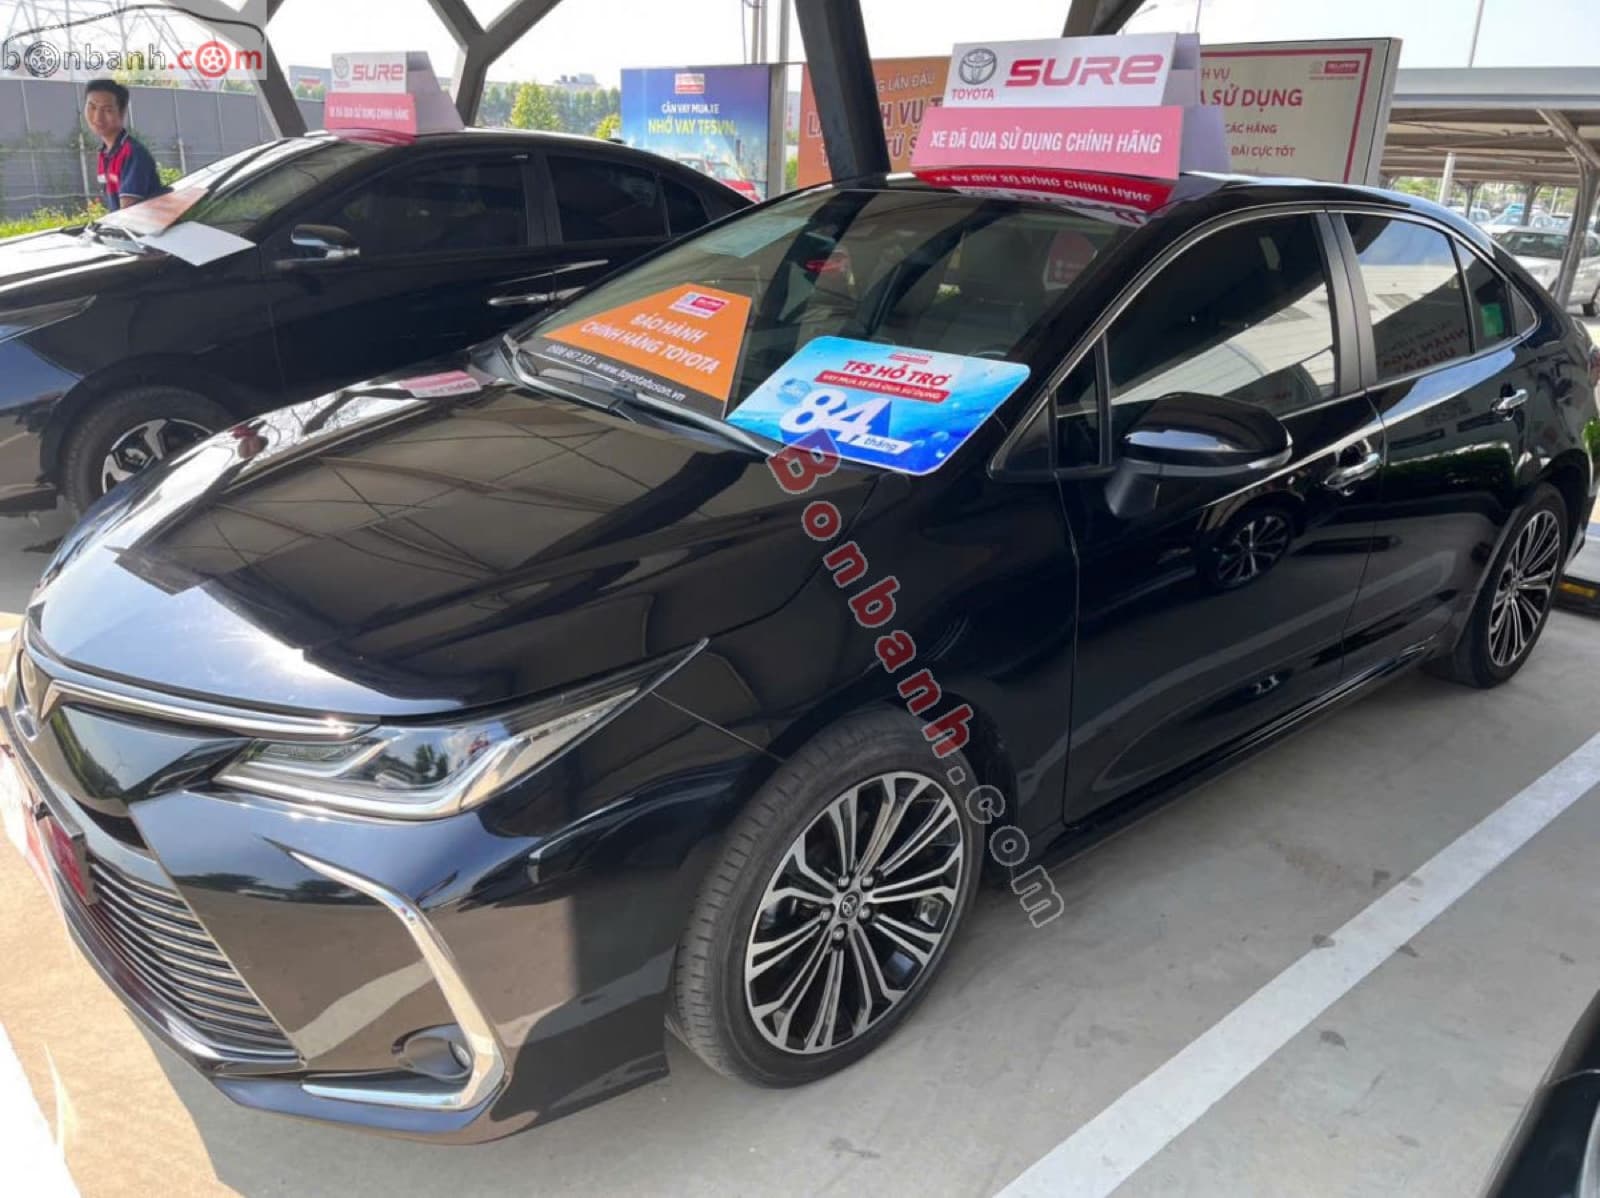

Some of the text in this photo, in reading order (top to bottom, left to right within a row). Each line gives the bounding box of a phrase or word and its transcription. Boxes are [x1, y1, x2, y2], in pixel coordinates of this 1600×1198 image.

[352, 64, 404, 80] SURE
[1005, 54, 1164, 87] SURE
[951, 88, 995, 101] TOYOTA
[1212, 83, 1239, 106] SỬ
[1241, 88, 1303, 113] DỤNG
[675, 118, 696, 135] VAY
[900, 98, 924, 129] VỤ
[930, 130, 947, 147] XE
[949, 127, 967, 148] ĐÃ
[969, 129, 996, 150] QUA
[999, 126, 1022, 151] SỬ
[1023, 131, 1062, 156] DỤNG
[1066, 127, 1112, 154] CHÍNH
[1116, 129, 1162, 154] HÃNG
[658, 344, 720, 374] TOYOTA
[843, 360, 877, 374] TFS
[780, 389, 882, 443] 84
[863, 436, 900, 452] tháng
